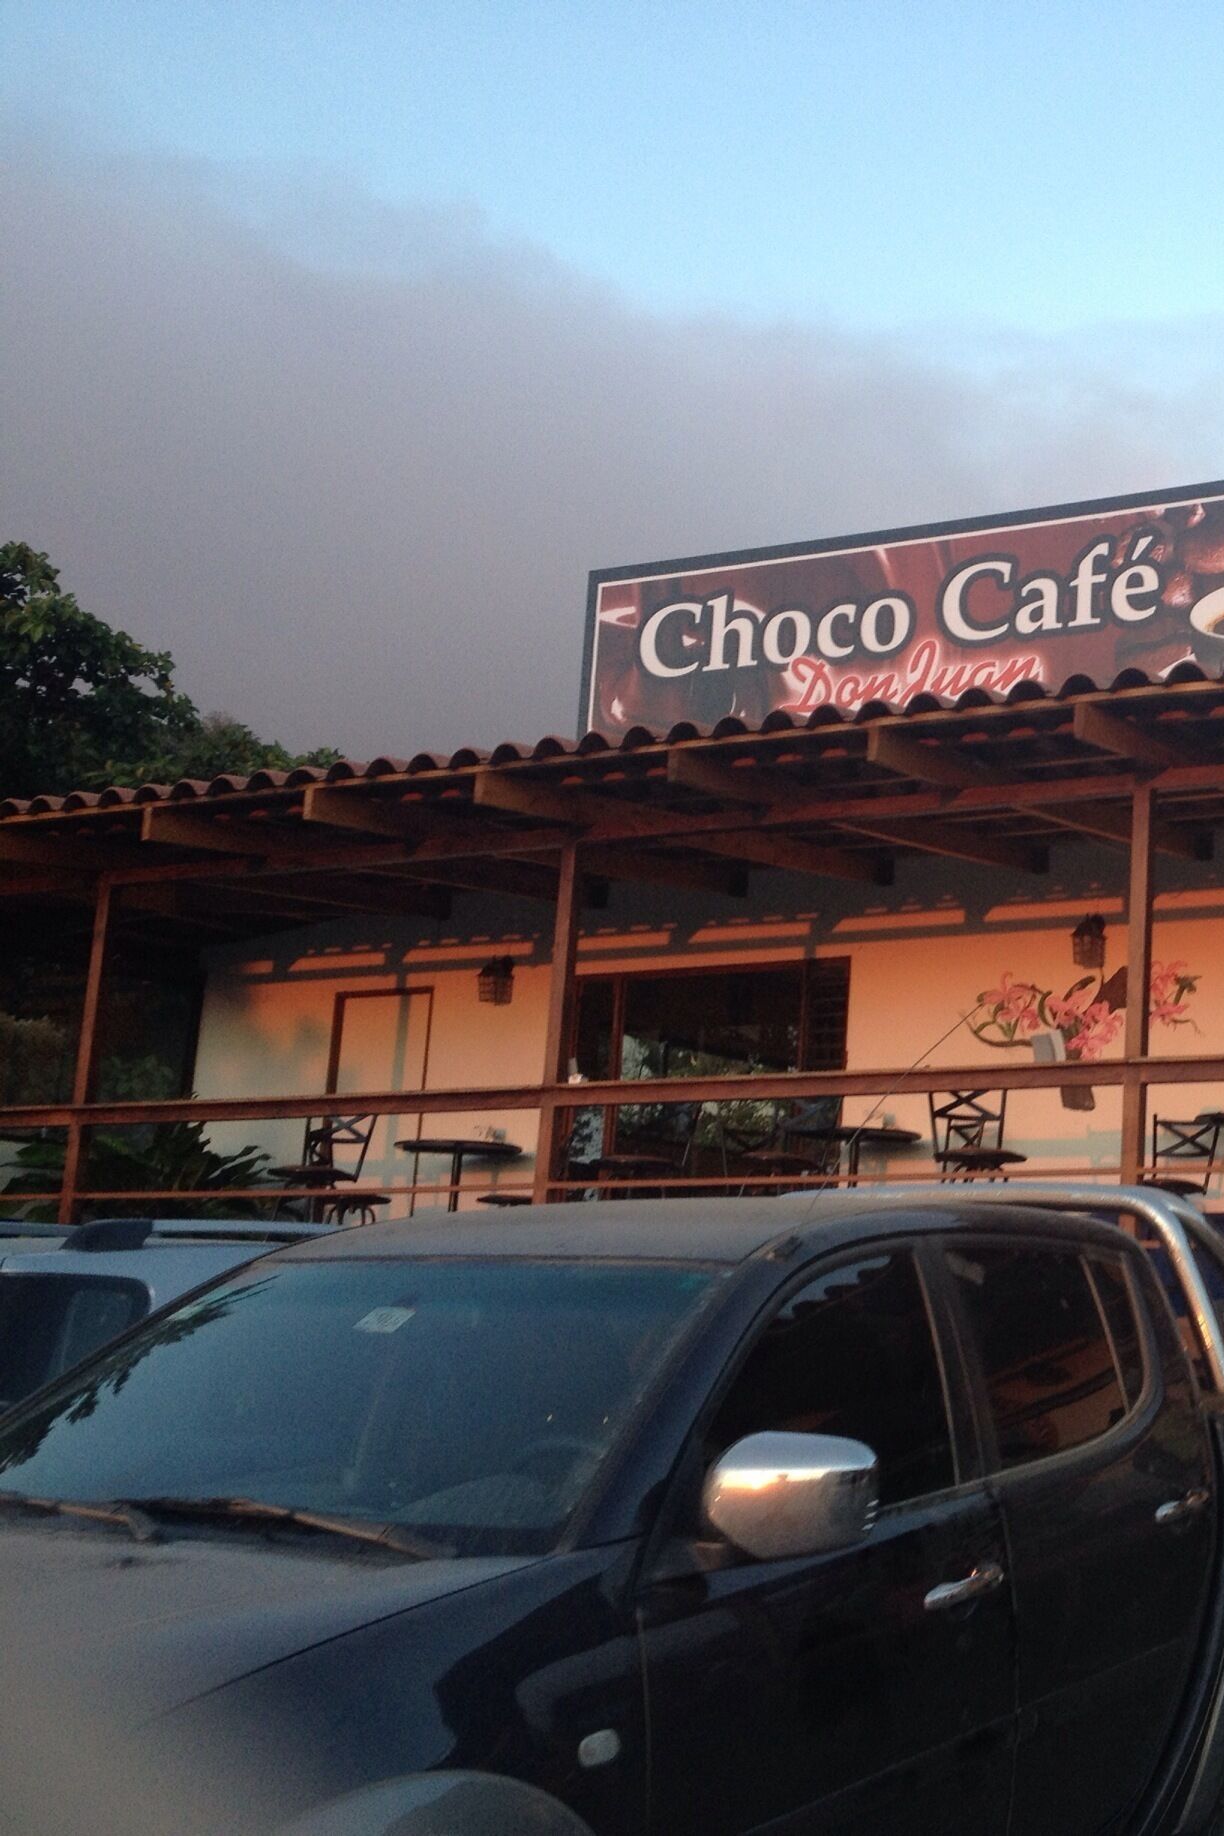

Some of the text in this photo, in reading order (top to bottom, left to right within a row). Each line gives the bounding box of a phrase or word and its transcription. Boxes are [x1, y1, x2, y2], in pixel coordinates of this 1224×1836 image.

[639, 537, 1160, 678] Choco Café
[779, 640, 1039, 712] Don Juan
